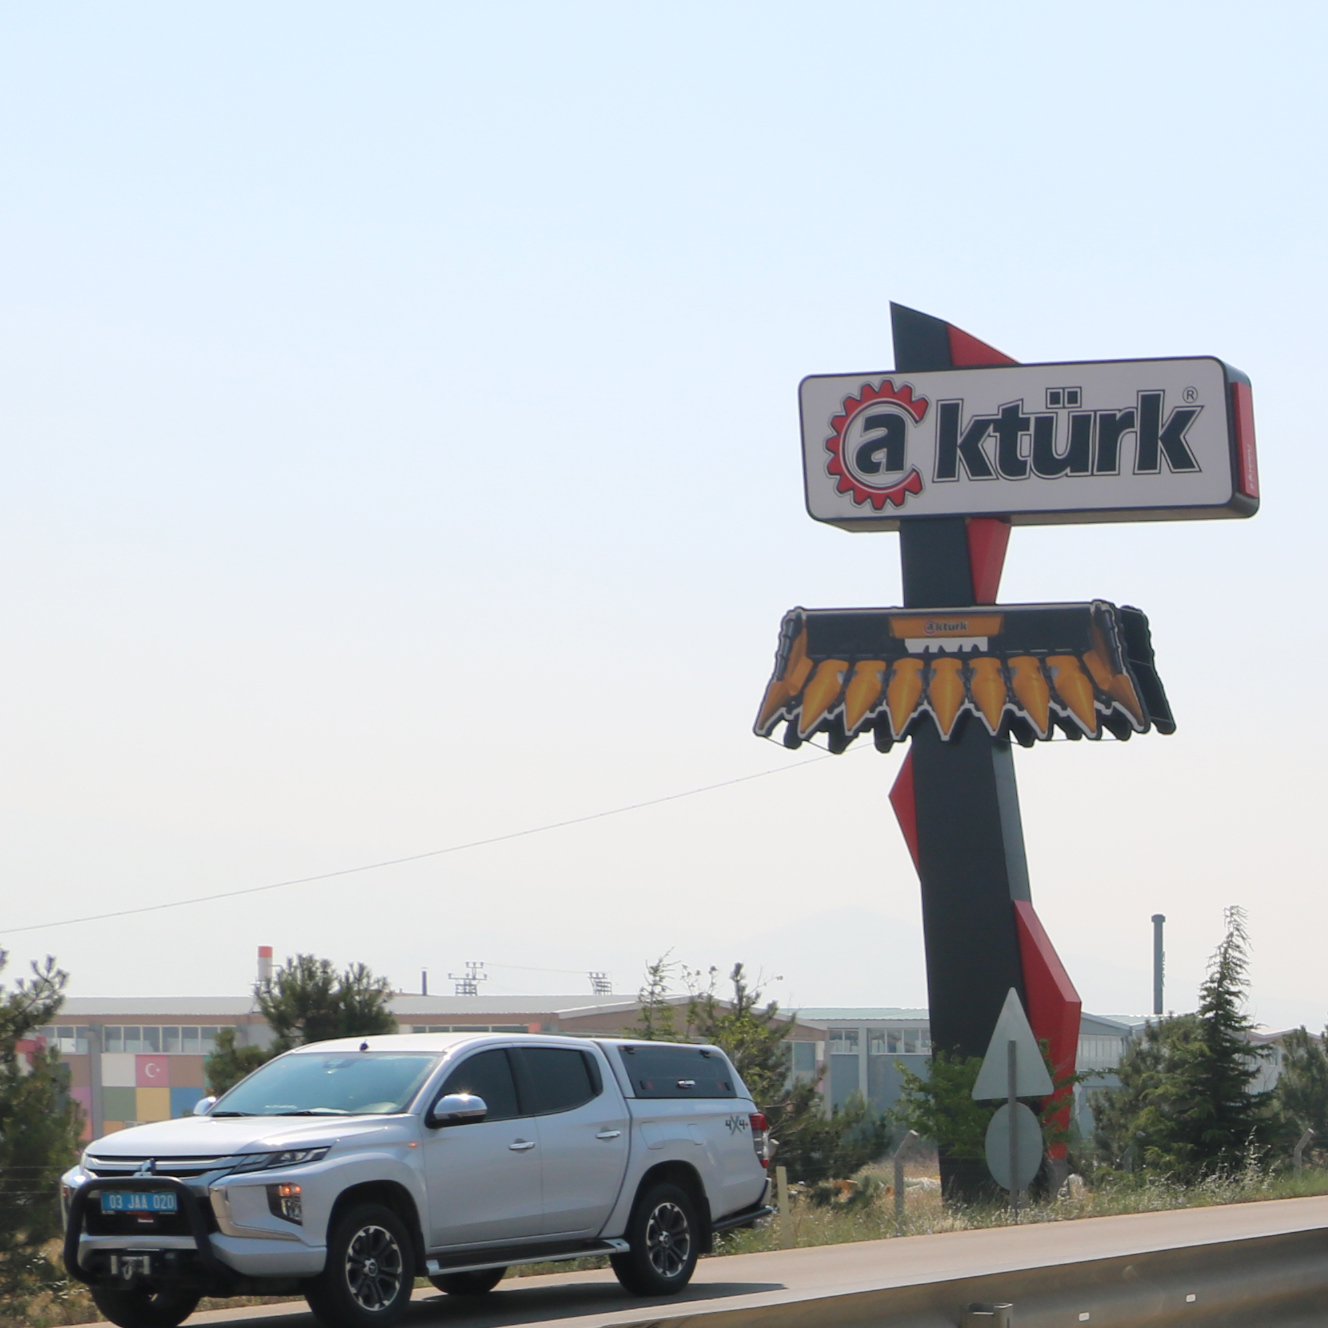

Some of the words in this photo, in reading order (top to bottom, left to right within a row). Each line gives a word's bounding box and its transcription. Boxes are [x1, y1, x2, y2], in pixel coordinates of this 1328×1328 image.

[850, 386, 1205, 484] aktürk
[109, 1194, 122, 1209] 03
[128, 1194, 148, 1209] JAA
[153, 1194, 174, 1209] 020
